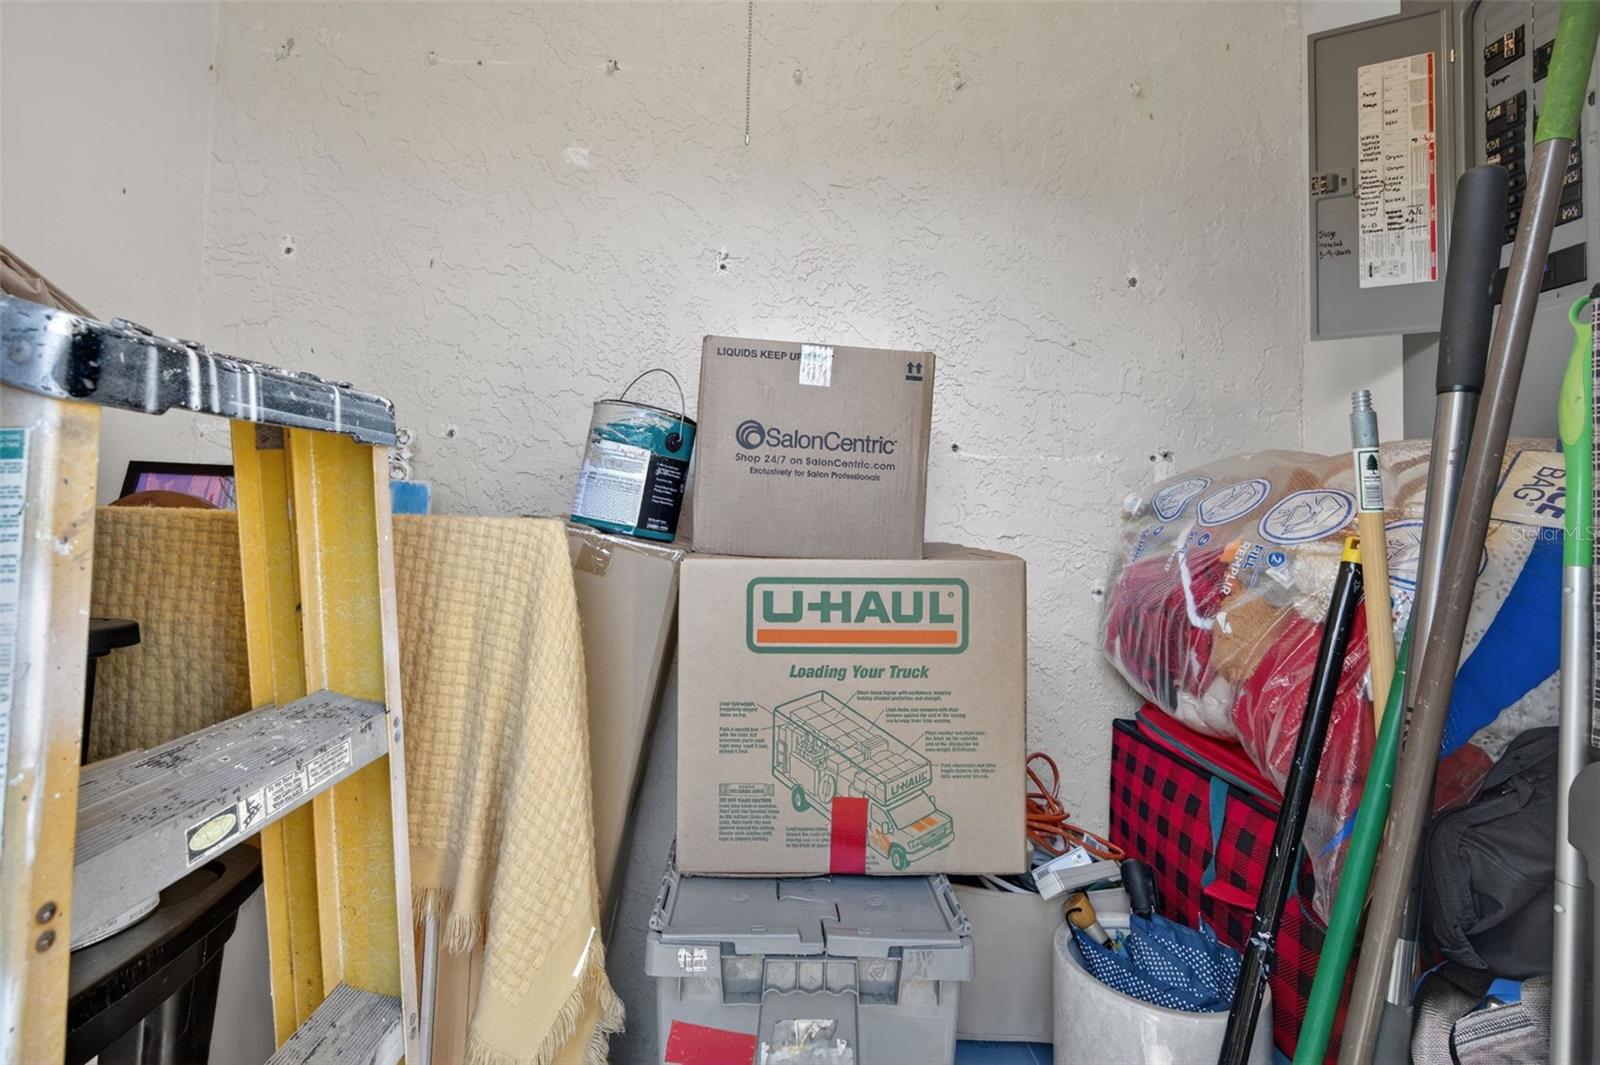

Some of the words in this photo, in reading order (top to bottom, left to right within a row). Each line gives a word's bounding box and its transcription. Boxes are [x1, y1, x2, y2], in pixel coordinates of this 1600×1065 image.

[717, 347, 758, 358] LIQUIDS
[760, 349, 787, 360] KEEP
[766, 427, 895, 454] SalonCentric
[735, 453, 761, 464] Shop
[764, 454, 786, 465] 24/7
[790, 457, 803, 465] on
[806, 457, 895, 471] SalonCentric.com
[750, 466, 792, 477] Exclusively
[794, 469, 805, 477] for
[807, 470, 829, 479] Salon
[831, 471, 881, 481] Professionals
[1514, 466, 1566, 502] BAG
[1244, 544, 1264, 570] FILL
[1220, 541, 1252, 596] REMPLIR
[789, 664, 848, 681] Loading
[852, 665, 886, 679] Your
[889, 665, 929, 679] Truck
